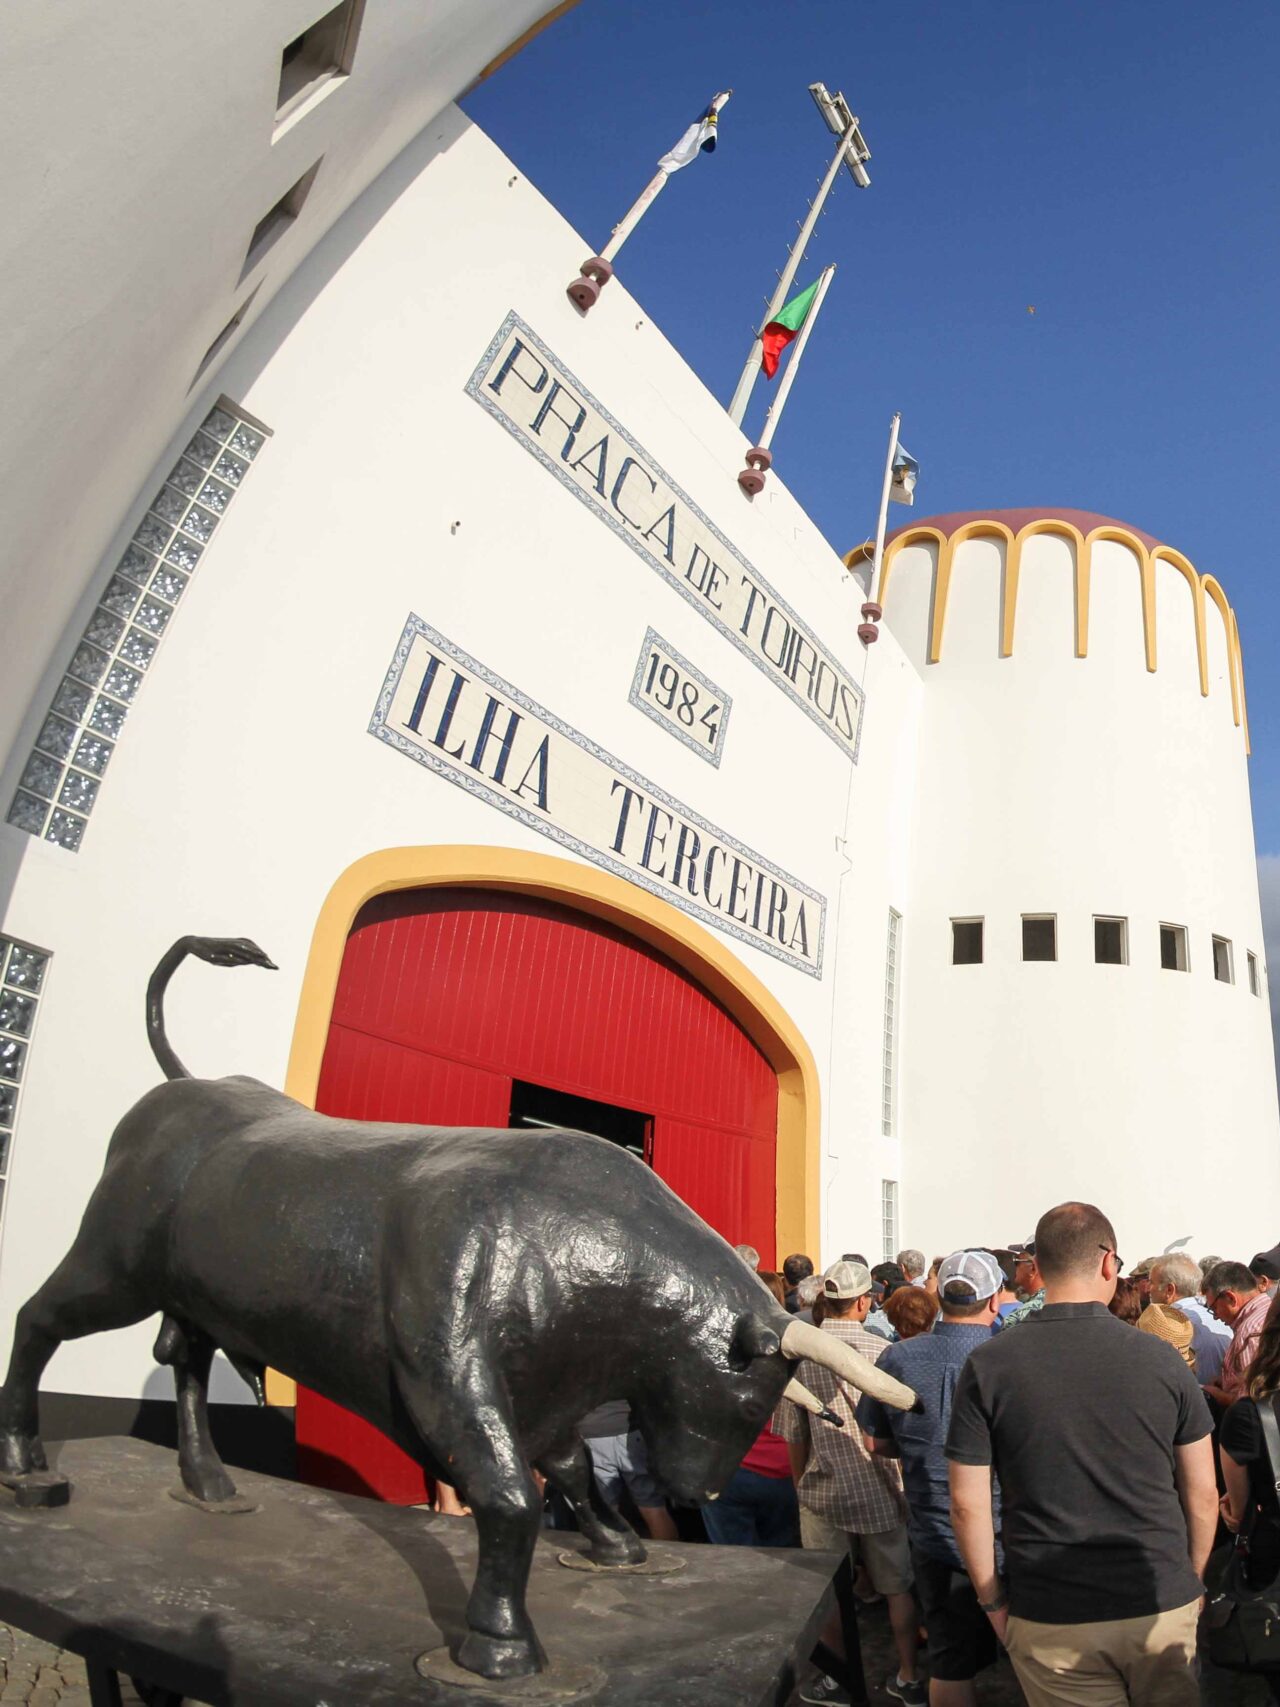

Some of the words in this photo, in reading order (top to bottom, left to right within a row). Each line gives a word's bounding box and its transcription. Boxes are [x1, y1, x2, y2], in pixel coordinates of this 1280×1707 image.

[488, 336, 676, 567] PRAÇA
[684, 542, 729, 611] DE
[739, 575, 858, 741] TOIROS
[401, 650, 552, 815] ILHA
[609, 778, 812, 959] TERCEIRA
[644, 651, 721, 746] 1984
